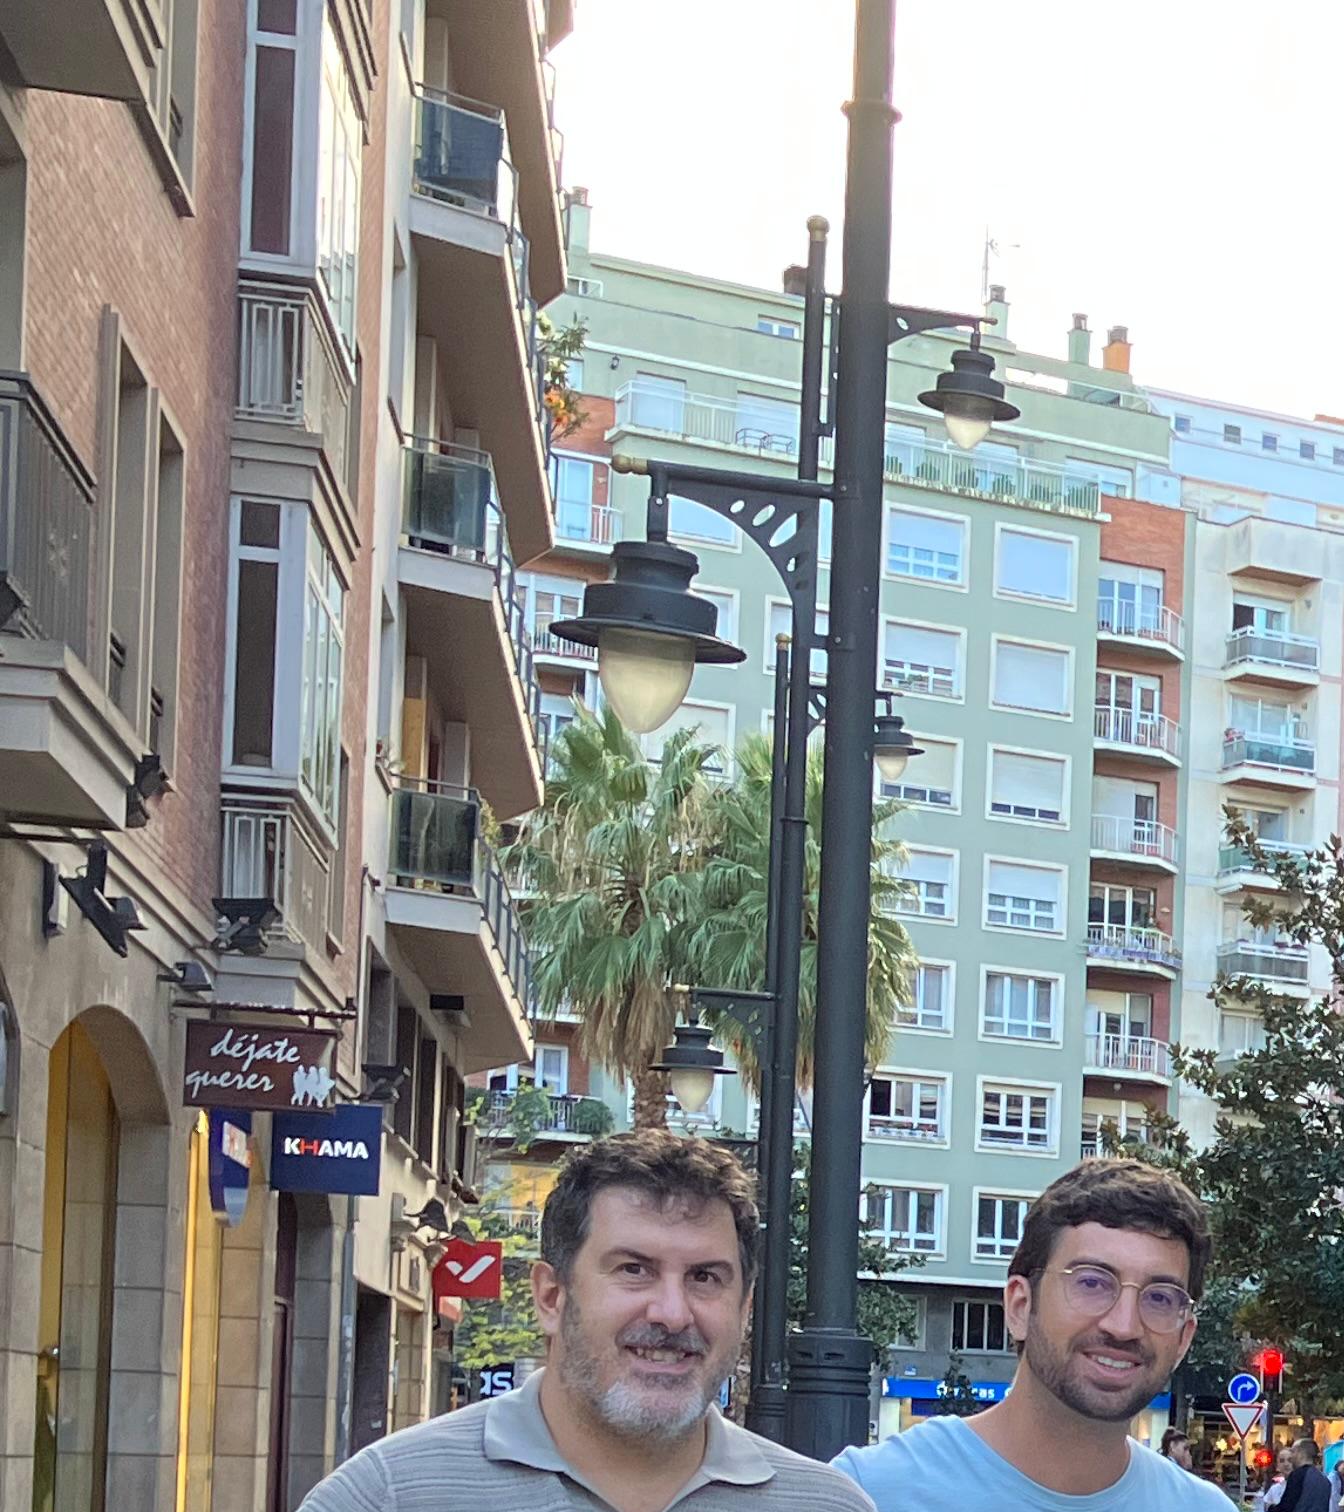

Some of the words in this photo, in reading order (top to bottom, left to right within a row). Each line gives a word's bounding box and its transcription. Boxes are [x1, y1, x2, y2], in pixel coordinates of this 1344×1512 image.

[211, 1028, 300, 1072] déjate
[185, 1069, 275, 1099] querer
[284, 1136, 369, 1160] KHAMA
